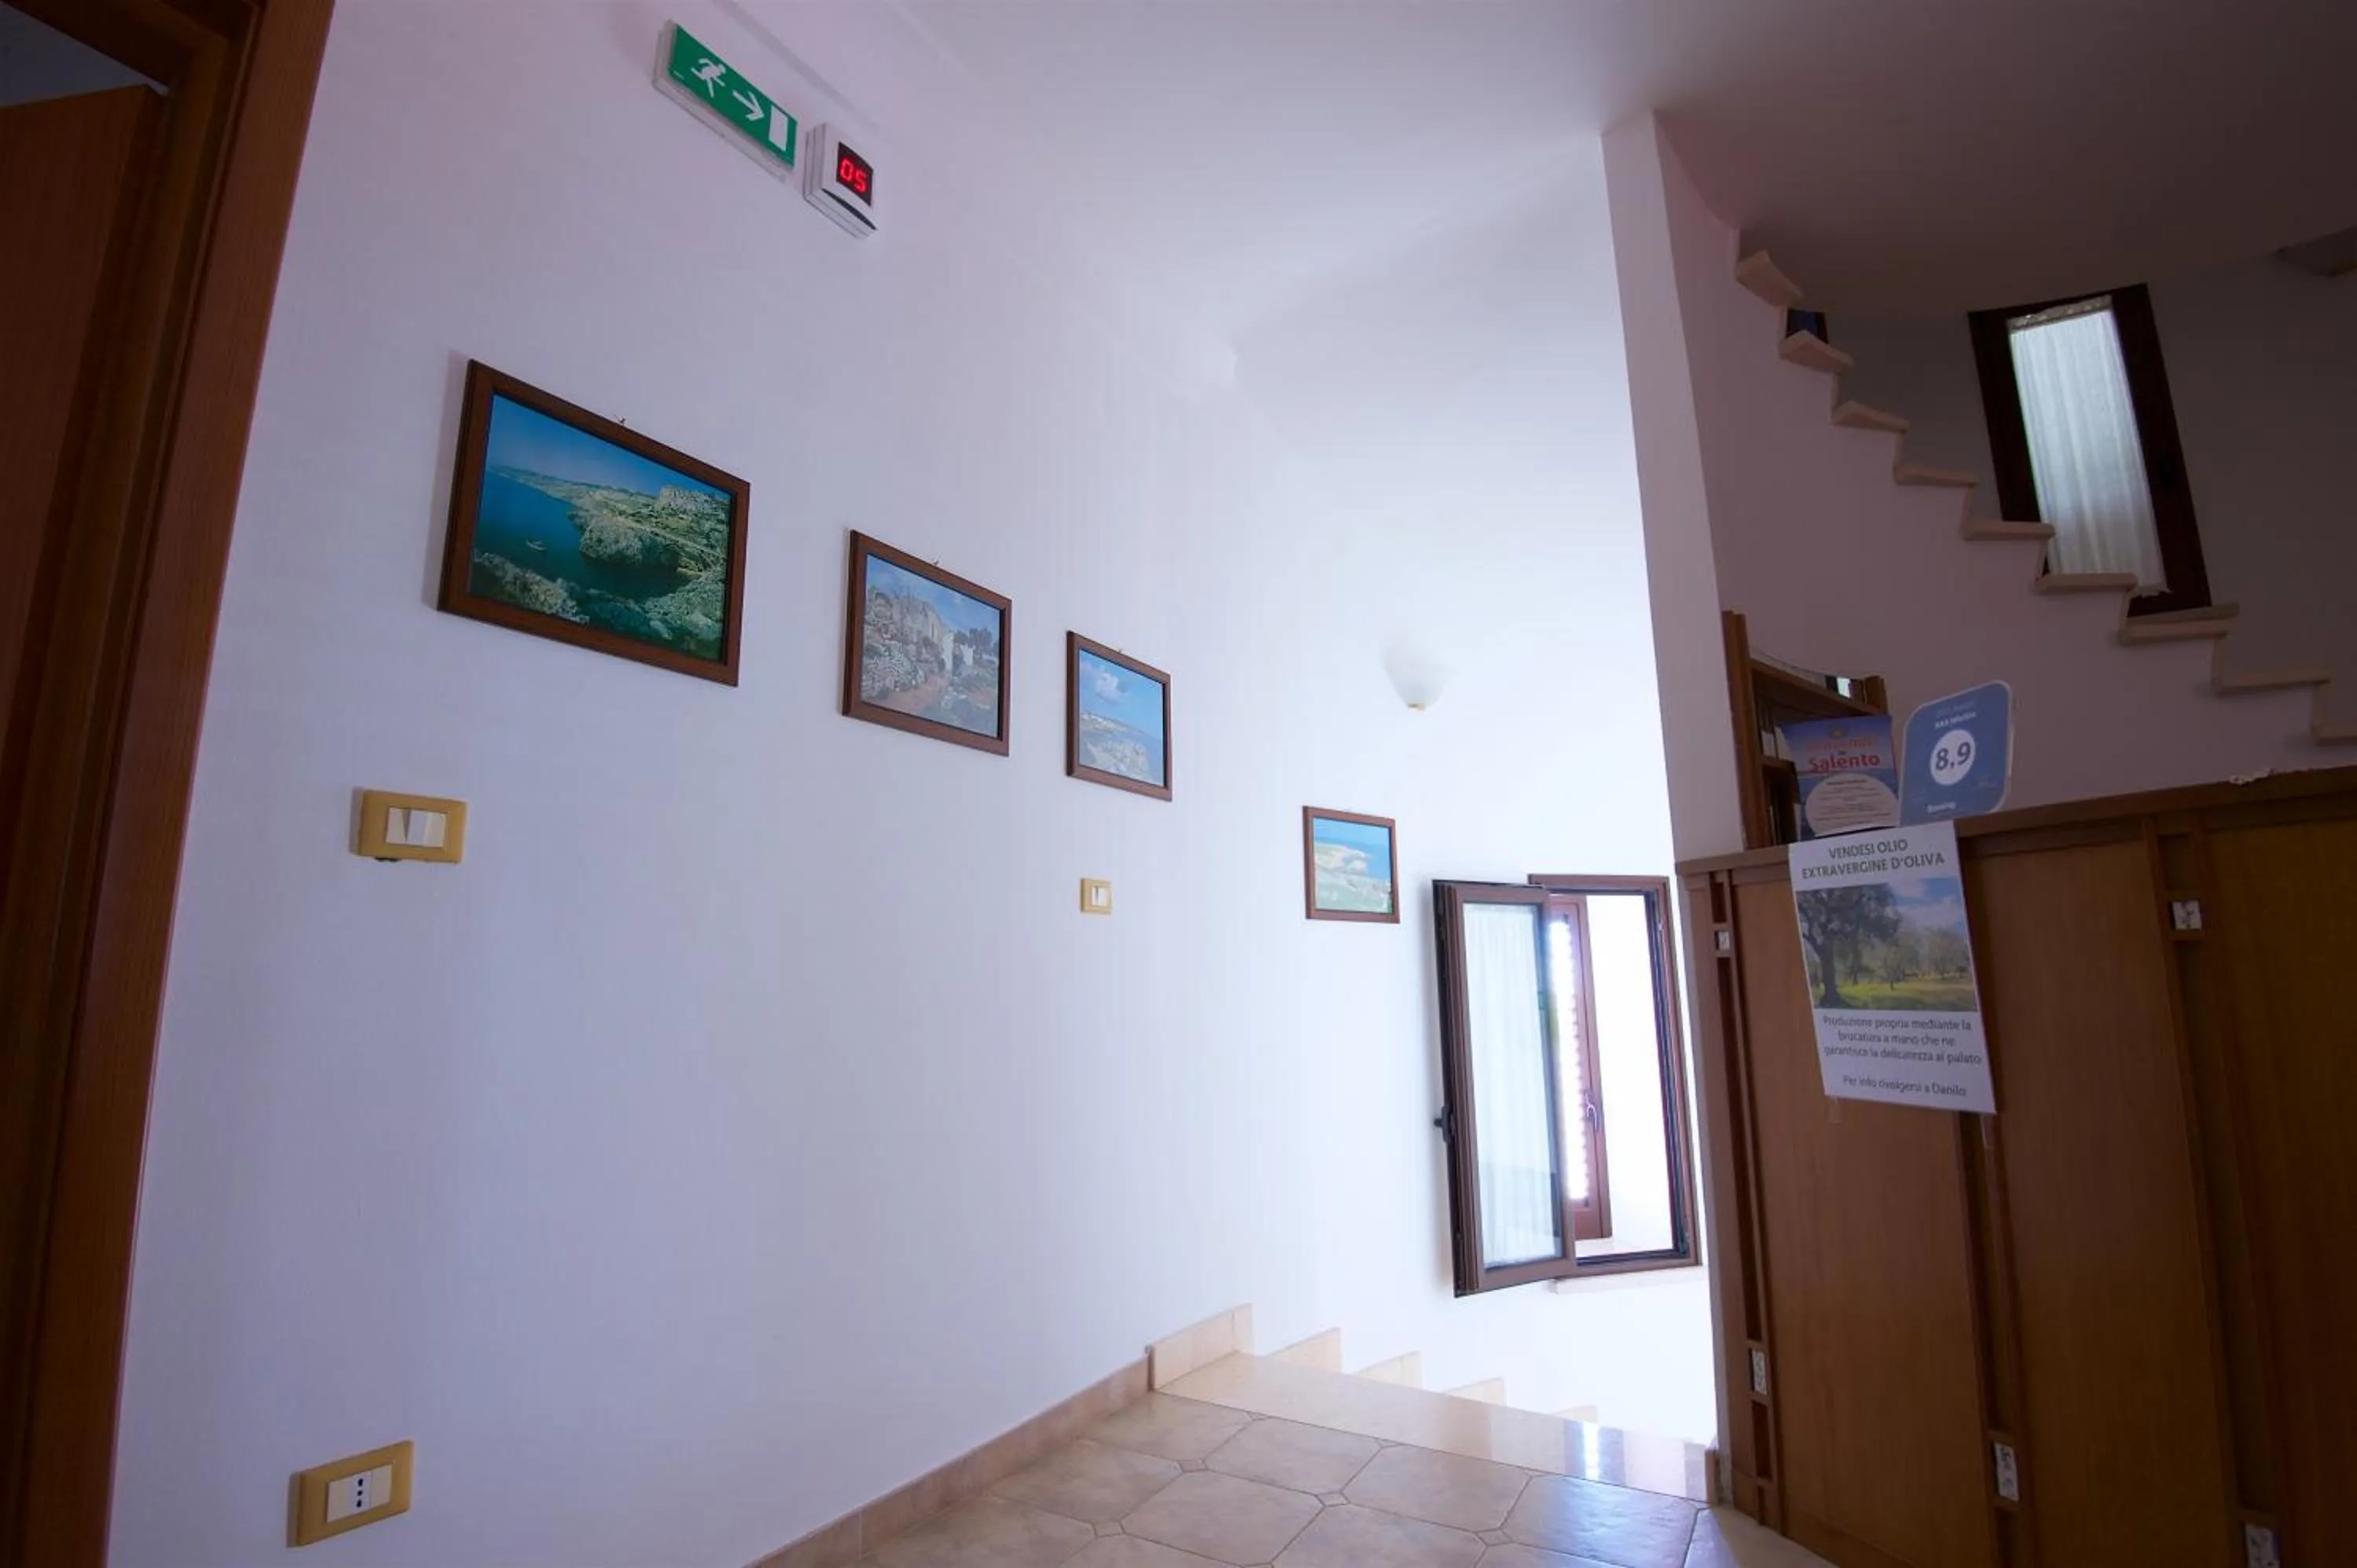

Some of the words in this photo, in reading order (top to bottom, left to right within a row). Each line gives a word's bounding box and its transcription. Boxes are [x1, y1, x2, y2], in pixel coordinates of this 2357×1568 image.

[1809, 753, 1880, 775] Salento
[1828, 843, 1874, 859] VENDESI
[1877, 838, 1908, 854] OLIO
[1802, 859, 1889, 879] EXTRAVERGINE
[1891, 852, 1945, 870] D'OLIVA
[1875, 1017, 1908, 1031] propria
[1911, 1018, 1959, 1031] mediante
[1962, 1019, 1971, 1031] la
[1838, 1031, 1882, 1042] brucatura
[1882, 1035, 1890, 1043] a
[1891, 1035, 1917, 1044] mano
[1920, 1034, 1940, 1046] che
[1869, 1046, 1879, 1057] la
[1879, 1047, 1934, 1061] delicatezza
[1935, 1052, 1945, 1062] al
[1946, 1053, 1982, 1065] palato
[1842, 1075, 1857, 1086] Per
[1859, 1075, 1877, 1087] info
[1923, 1084, 1930, 1094] a
[1931, 1082, 1967, 1096] Danilo
